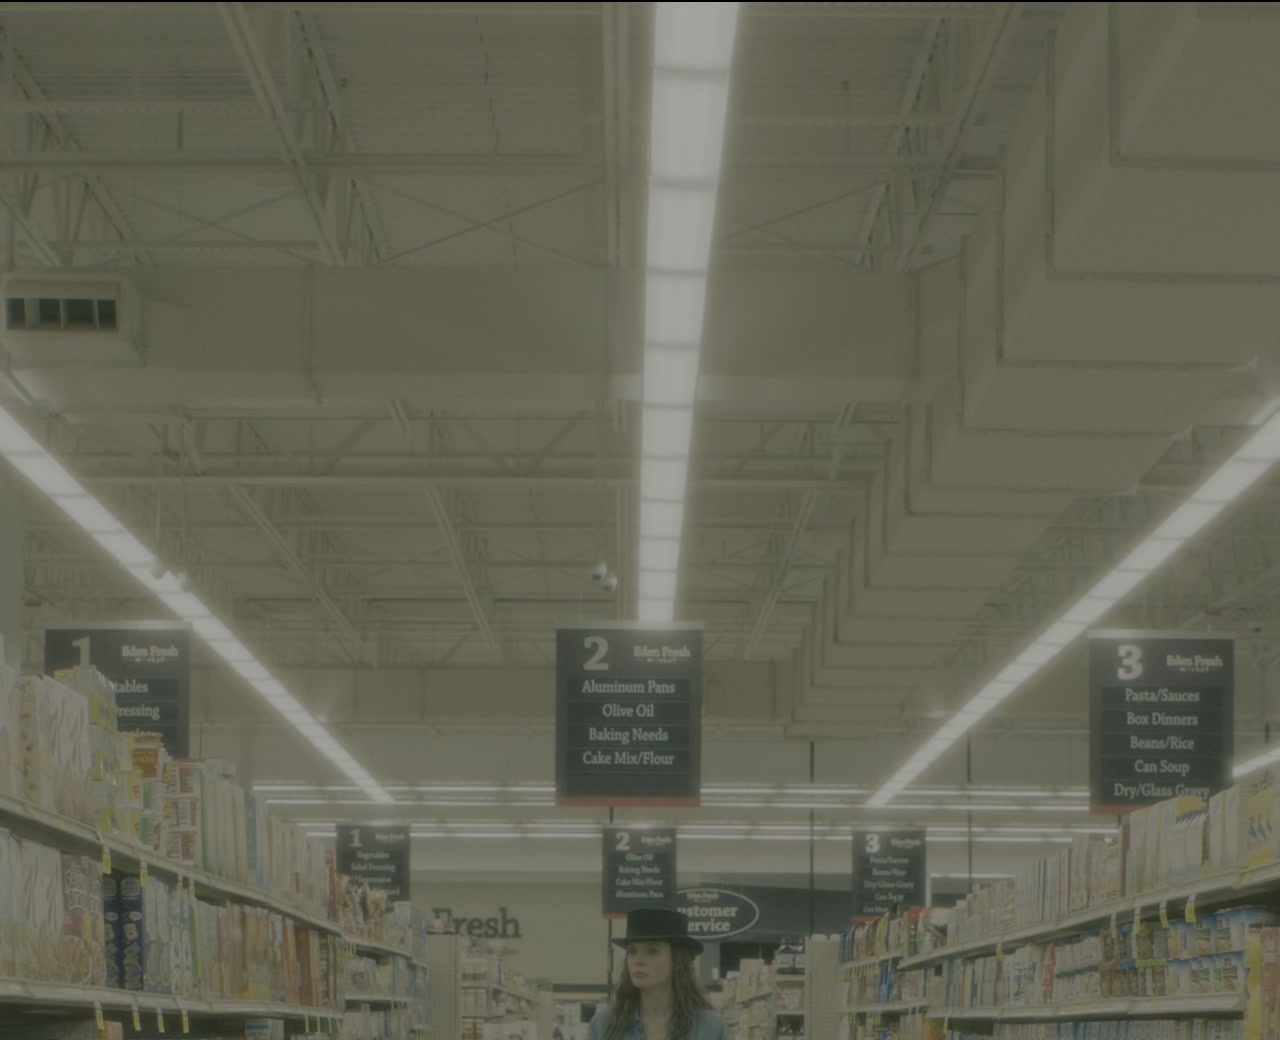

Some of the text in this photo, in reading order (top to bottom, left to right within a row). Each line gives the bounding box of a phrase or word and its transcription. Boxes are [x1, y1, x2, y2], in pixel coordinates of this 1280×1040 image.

[122, 645, 148, 657] Eden
[584, 637, 608, 670] 2
[1117, 644, 1144, 681] 3
[1166, 655, 1222, 666] Eden Fresh
[582, 680, 675, 693] Aluminum Pans
[1125, 688, 1200, 702] Pasta/Sauces
[116, 704, 160, 721] ressing
[602, 704, 654, 717] Olive Oil
[1127, 712, 1198, 726] Box Dinners
[589, 728, 668, 744] Baking Needs
[1130, 736, 1194, 750] Beans/Rice
[583, 752, 674, 766] Cake Mix/Flour
[1135, 760, 1190, 776] Can Soup
[1114, 783, 1209, 799] Dry/Glass Gravy
[350, 829, 362, 847] 1
[616, 832, 630, 851] 2
[865, 833, 880, 853] 3
[677, 905, 738, 917] ustomer
[688, 919, 730, 931] ervice
